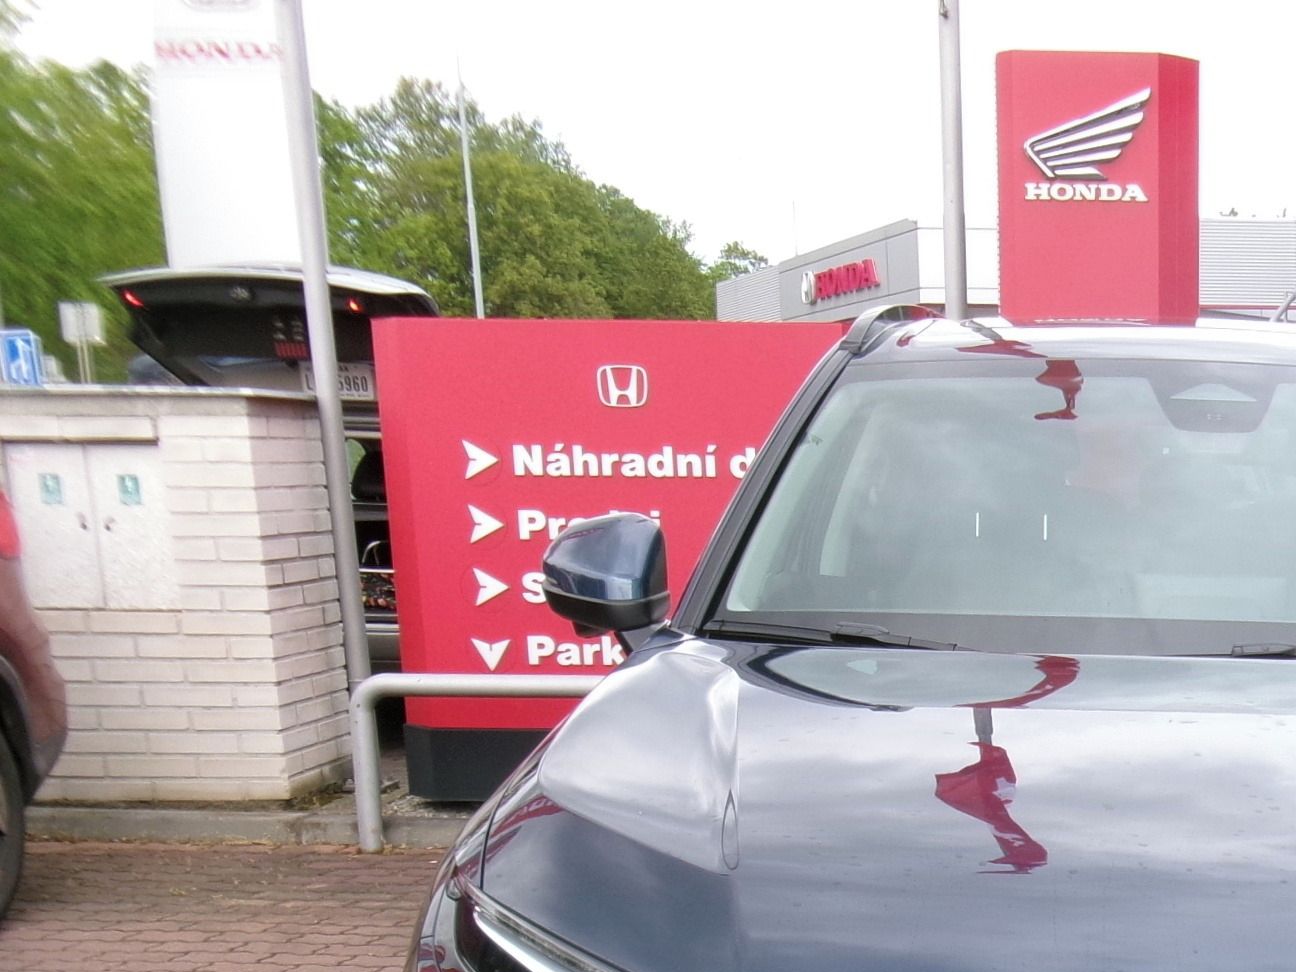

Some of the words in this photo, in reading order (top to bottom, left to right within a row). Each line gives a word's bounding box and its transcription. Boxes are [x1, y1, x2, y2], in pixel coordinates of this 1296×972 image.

[1024, 182, 1149, 203] HONDA
[814, 258, 880, 300] HONDA
[512, 443, 717, 478] Náhradní
